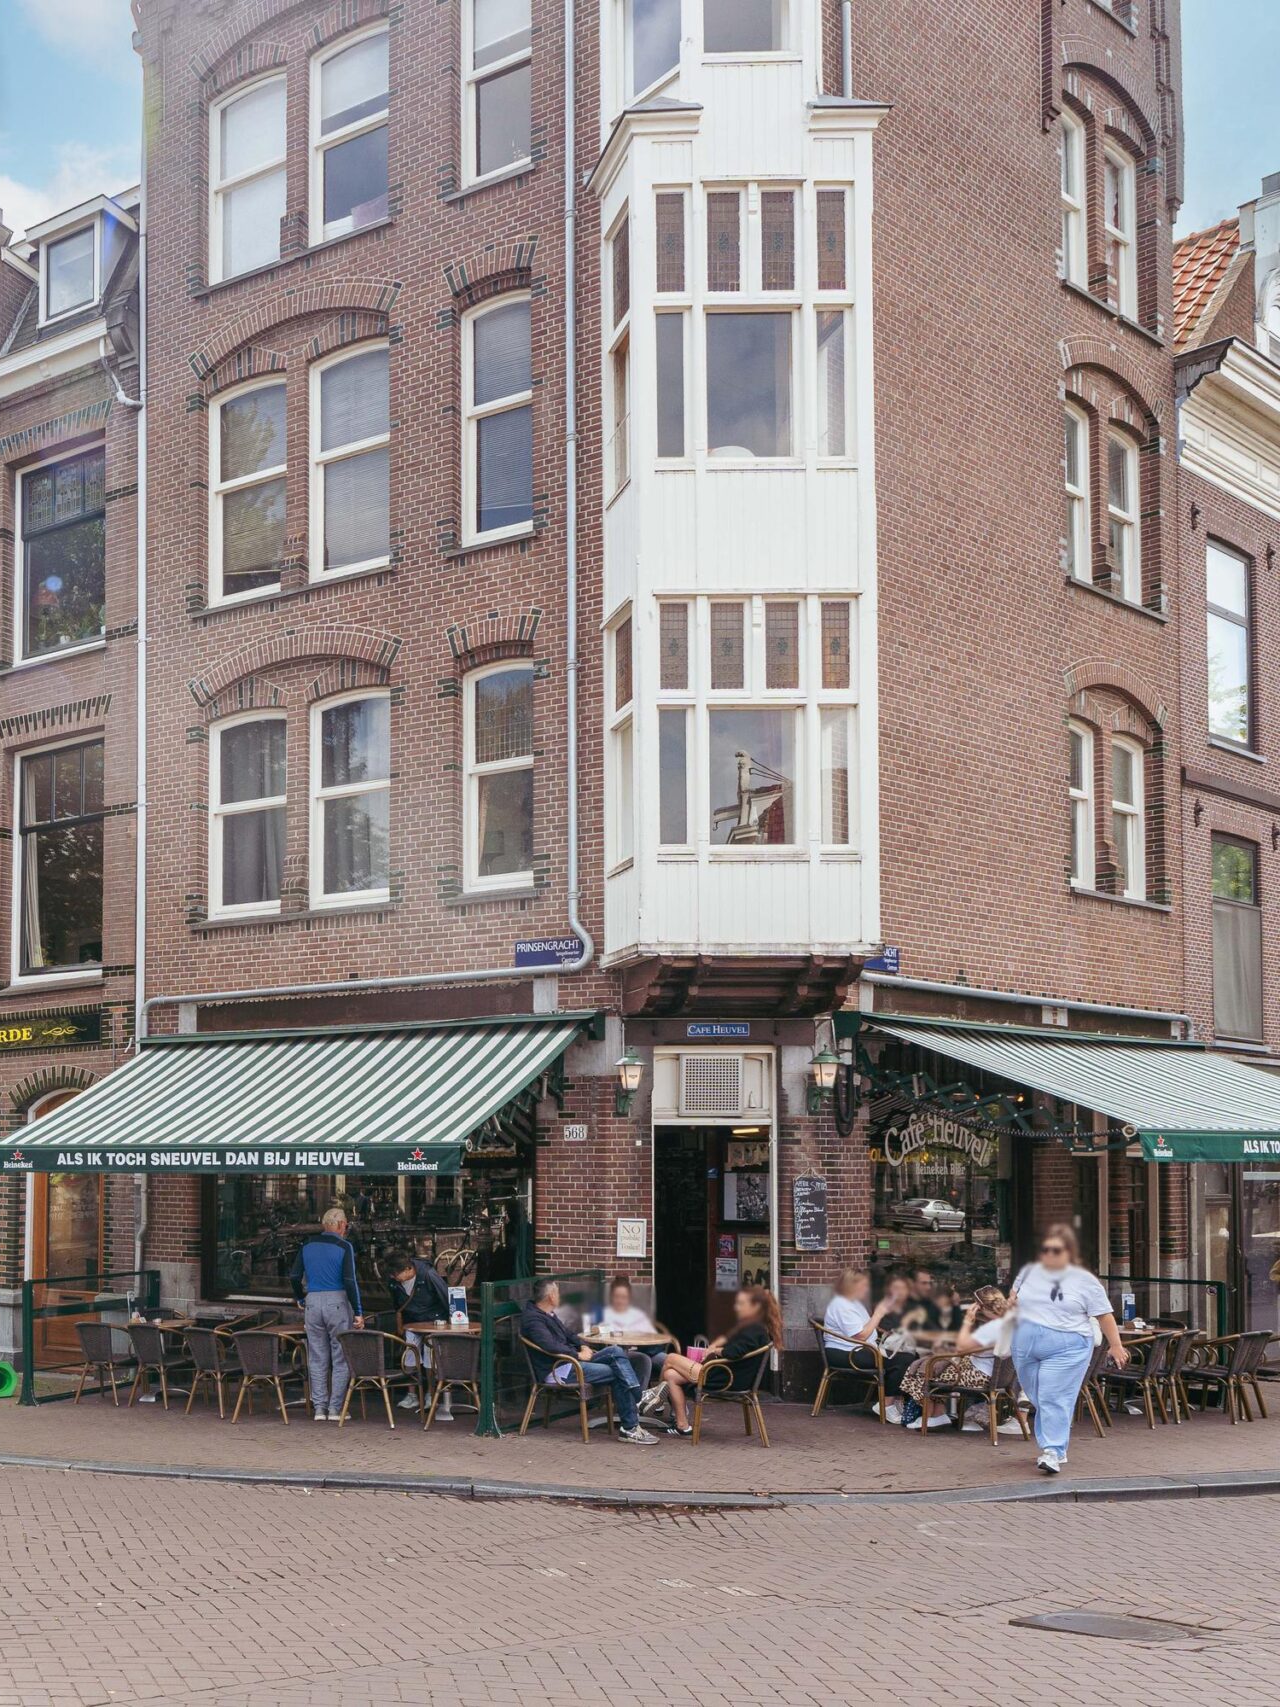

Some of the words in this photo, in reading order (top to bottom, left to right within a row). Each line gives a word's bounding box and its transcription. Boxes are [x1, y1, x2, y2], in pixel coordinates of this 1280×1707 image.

[516, 940, 580, 953] PRINSENGRACHT
[883, 947, 898, 958] ACHT
[712, 1025, 748, 1034] HEUVEL
[565, 1126, 585, 1139] 568
[885, 1113, 927, 1167] Café
[1243, 1140, 1259, 1154] ALS
[1259, 1140, 1269, 1154] IK
[1270, 1140, 1280, 1154] TO
[3, 1161, 33, 1169] Heineken
[57, 1152, 84, 1166] ALS
[87, 1152, 102, 1166] IK
[106, 1152, 146, 1166] TOCH
[150, 1152, 221, 1166] SNEUVEL
[225, 1152, 260, 1166] DAN
[264, 1152, 291, 1166] BIJ
[295, 1152, 365, 1167] HEUVEL
[397, 1161, 439, 1171] Heineken
[915, 1162, 949, 1175] Heineken
[622, 1224, 641, 1234] NO
